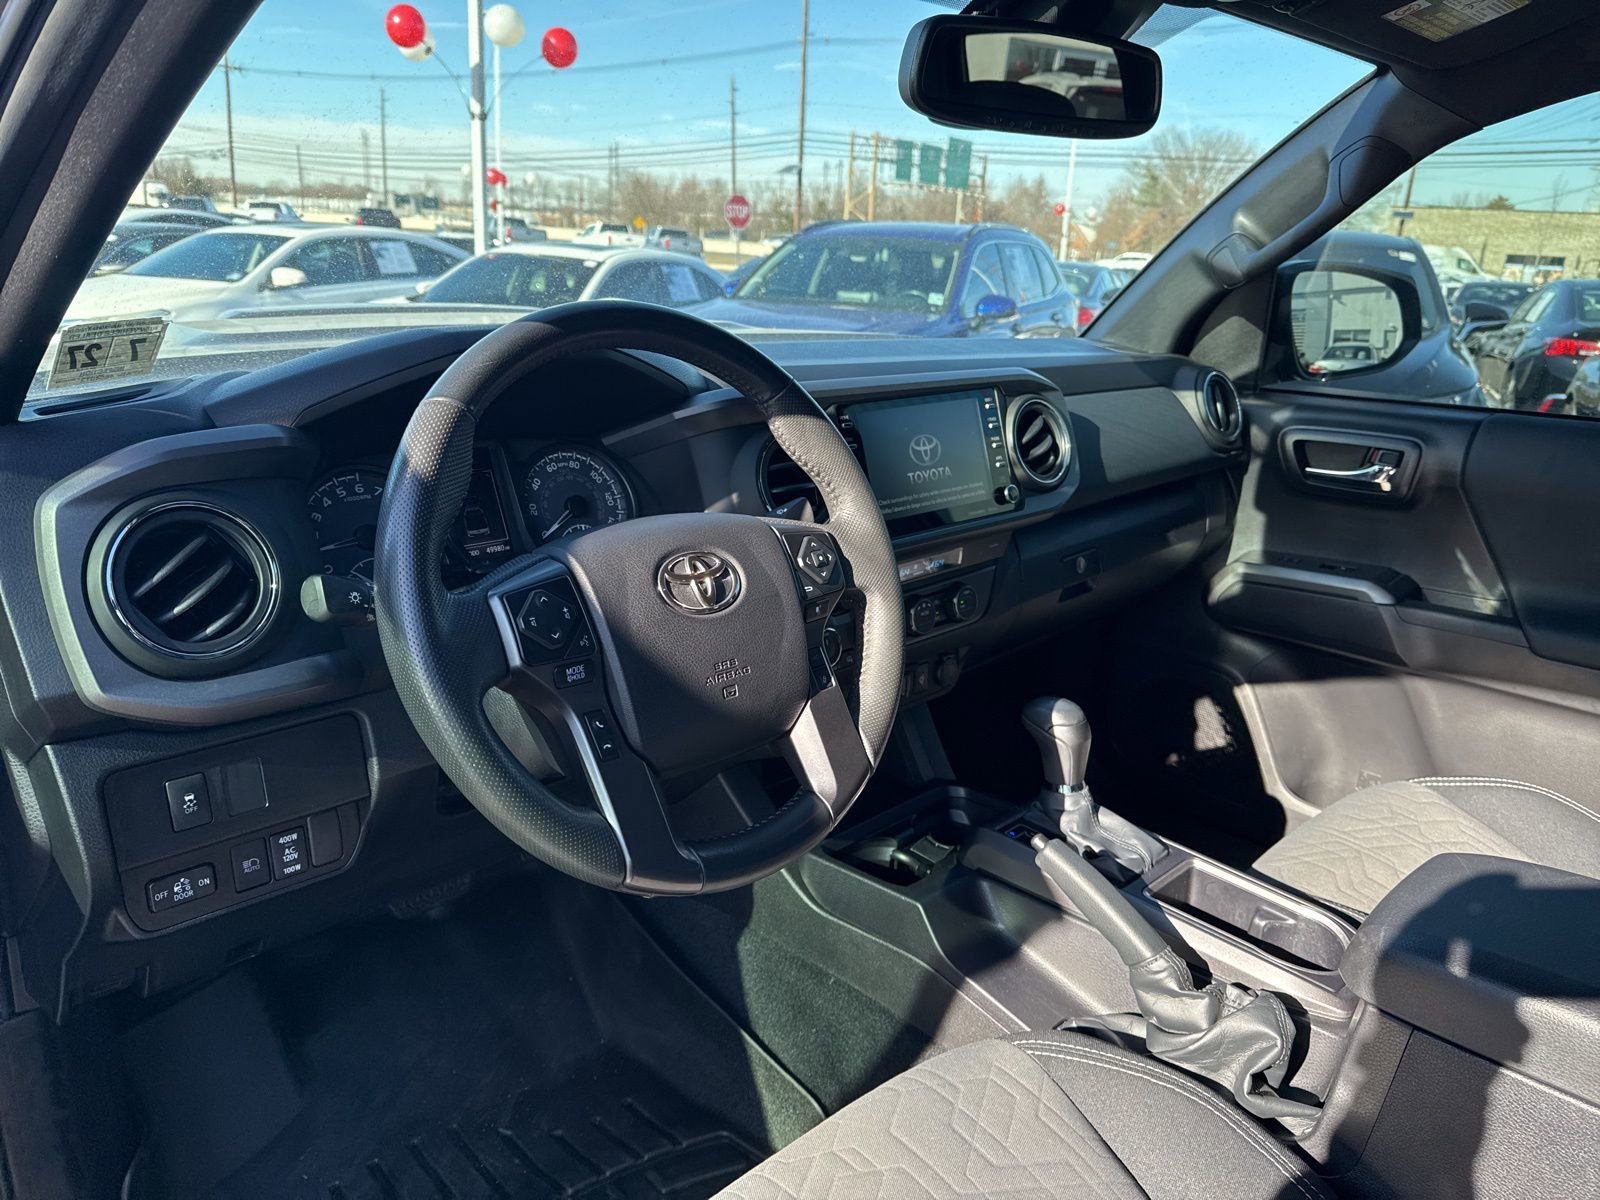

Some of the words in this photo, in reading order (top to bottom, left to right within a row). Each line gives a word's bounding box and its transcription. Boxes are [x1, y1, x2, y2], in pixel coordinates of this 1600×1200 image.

[727, 204, 749, 218] STOP
[546, 462, 557, 472] 60
[569, 461, 580, 469] 80
[590, 470, 603, 484] 100
[907, 466, 952, 484] TOYOTA
[354, 483, 364, 493] 6
[531, 478, 541, 491] 40
[336, 486, 347, 498] 5
[374, 486, 383, 496] 7
[322, 496, 332, 507] 4
[604, 492, 615, 506] 120
[529, 503, 538, 516] 20
[311, 512, 322, 522] 3
[566, 664, 585, 676] MODE
[713, 658, 738, 671] SRS
[571, 671, 586, 681] HOLD
[706, 666, 751, 687] AIRBAG
[184, 805, 198, 815] OFF
[278, 833, 298, 844] 400W
[284, 846, 296, 855] AC
[282, 852, 299, 862] 120V
[243, 864, 261, 873] AUTO
[283, 864, 302, 875] 100W
[154, 890, 169, 901] OFF
[198, 878, 210, 887] ON
[173, 890, 194, 901] DOOR
